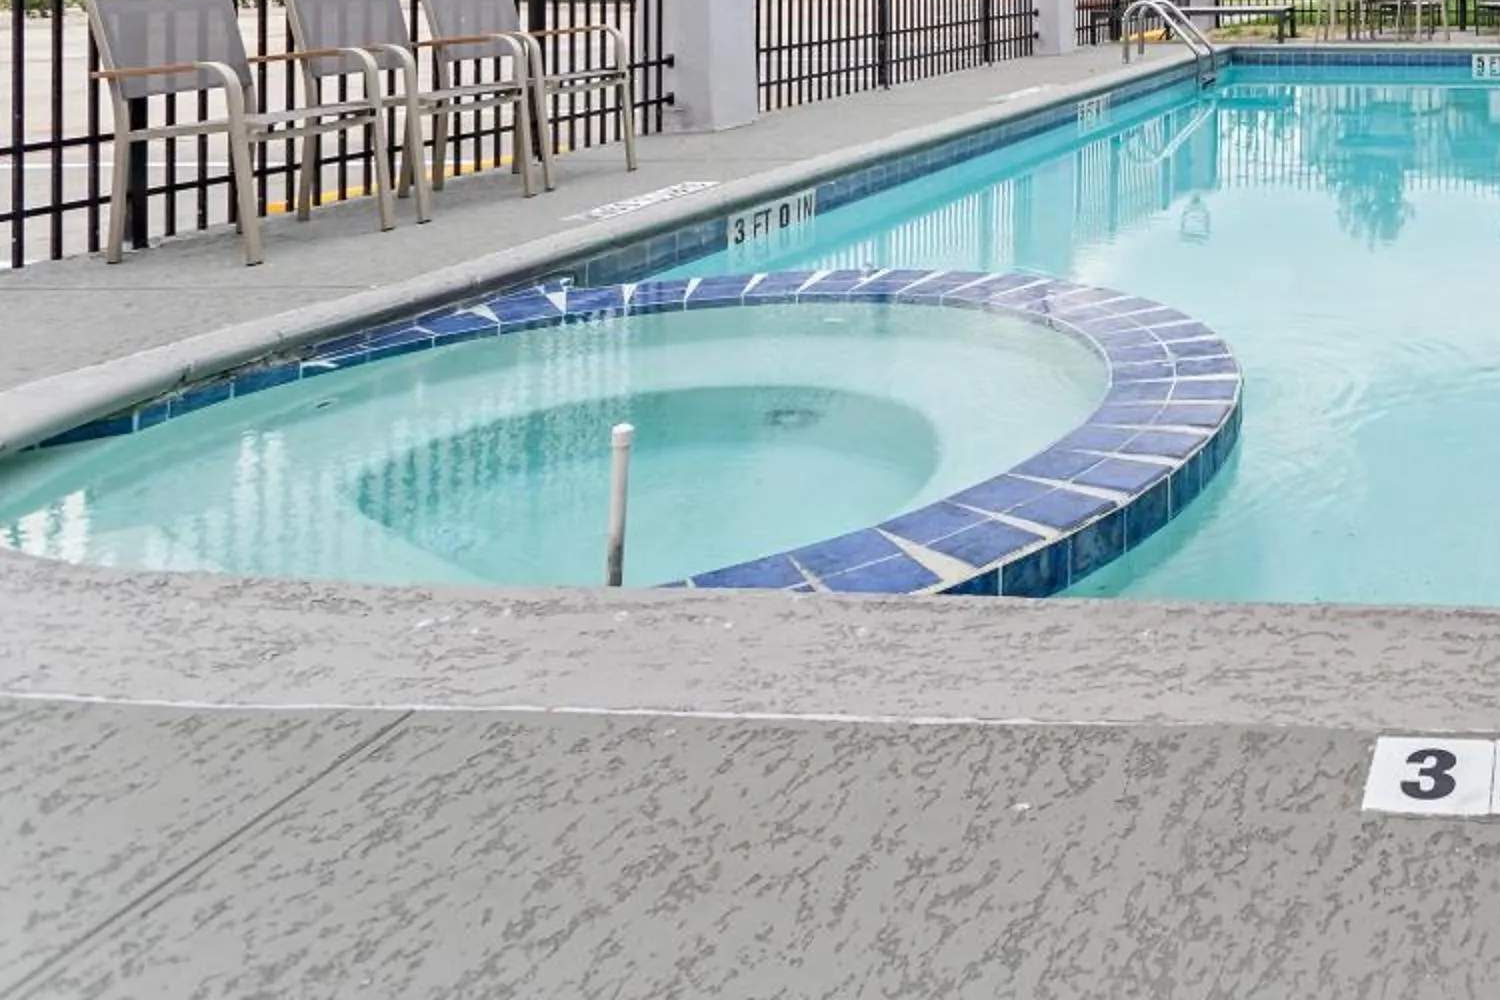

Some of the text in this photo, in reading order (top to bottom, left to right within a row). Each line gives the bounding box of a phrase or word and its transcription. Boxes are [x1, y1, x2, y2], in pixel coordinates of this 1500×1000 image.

[734, 217, 745, 245] 3
[753, 207, 772, 240] FT
[797, 193, 813, 222] IN
[1401, 749, 1457, 800] 3
